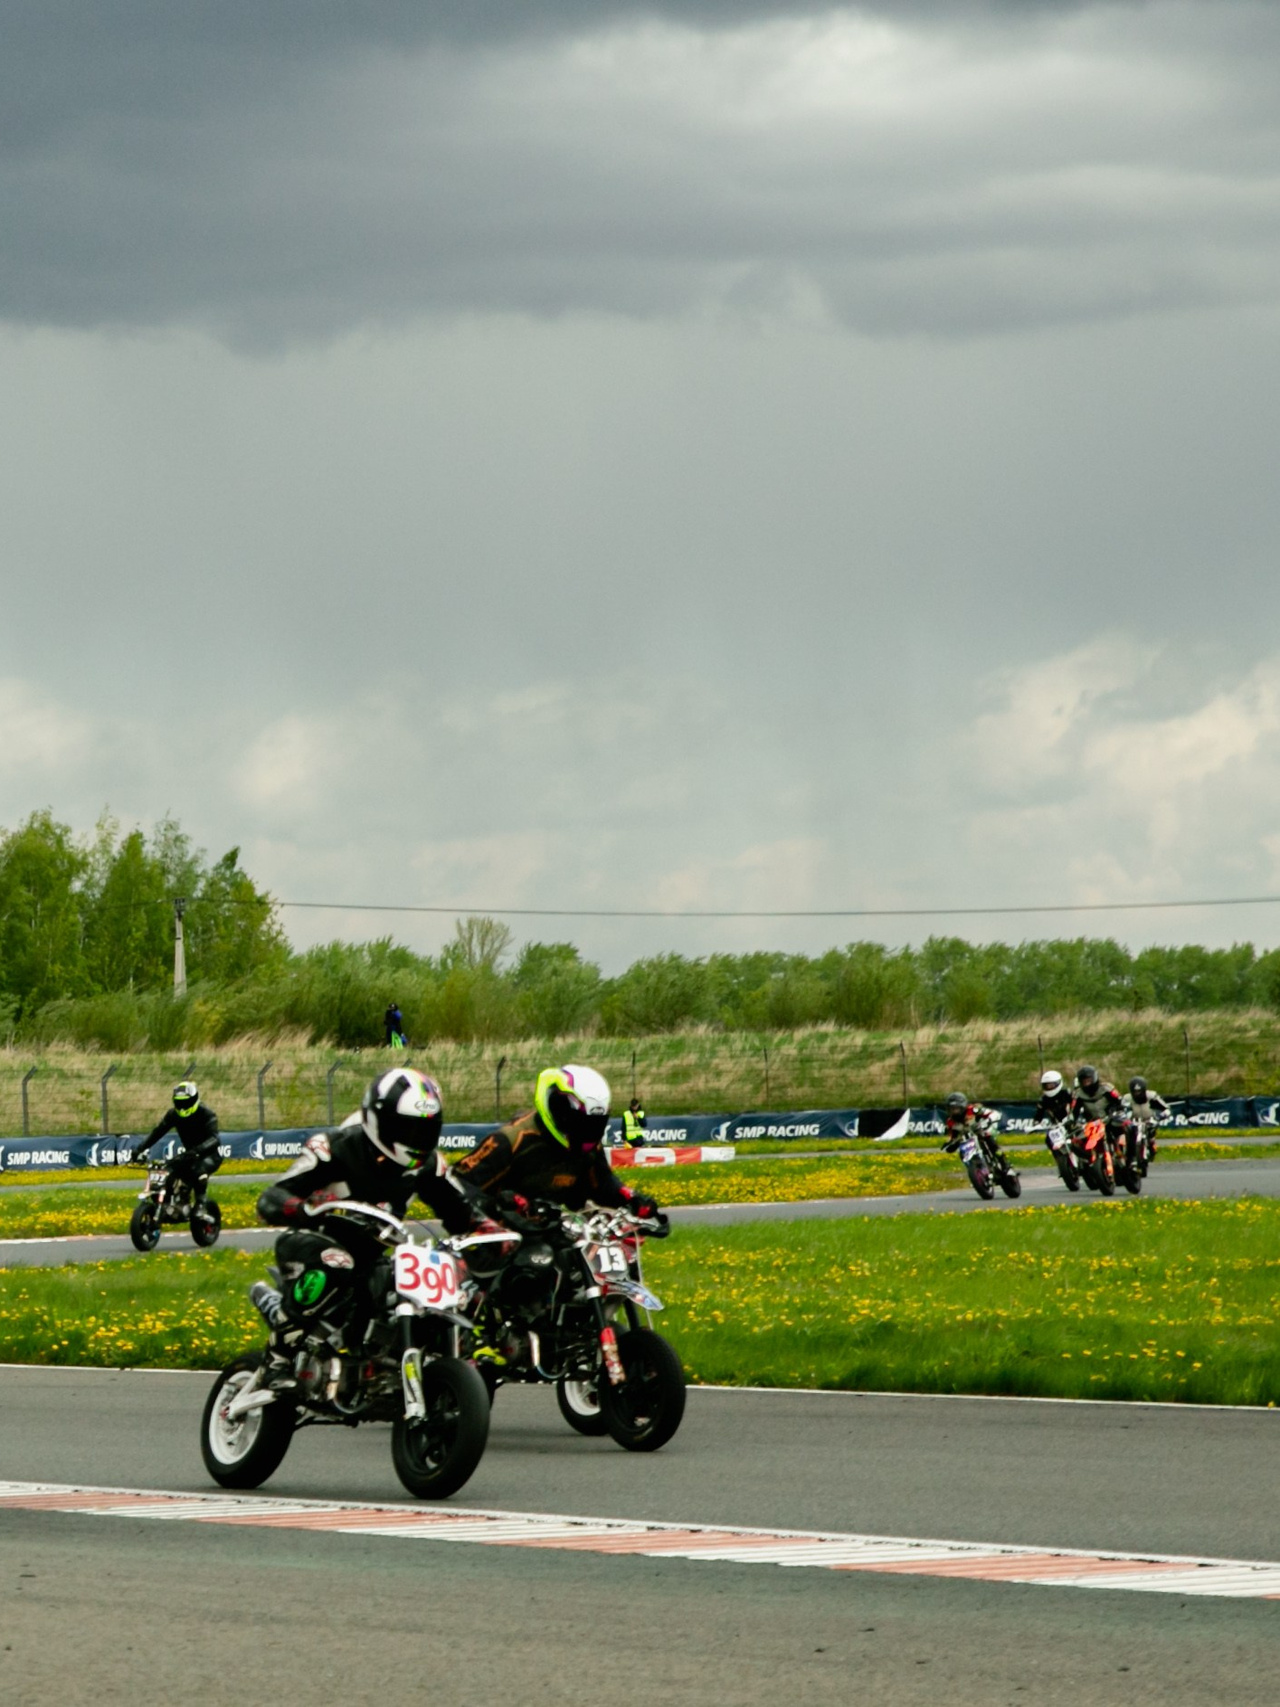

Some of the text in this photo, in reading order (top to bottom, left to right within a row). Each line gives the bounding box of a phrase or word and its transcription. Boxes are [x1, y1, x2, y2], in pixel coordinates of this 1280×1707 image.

[1175, 1112, 1230, 1126] RCING
[644, 1128, 687, 1142] RACING
[734, 1123, 821, 1139] SMP RACING
[276, 1142, 302, 1155] RACING
[437, 1135, 476, 1148] RACING
[7, 1150, 70, 1166] SMP RACING
[596, 1247, 627, 1273] 13
[397, 1252, 457, 1304] 390
